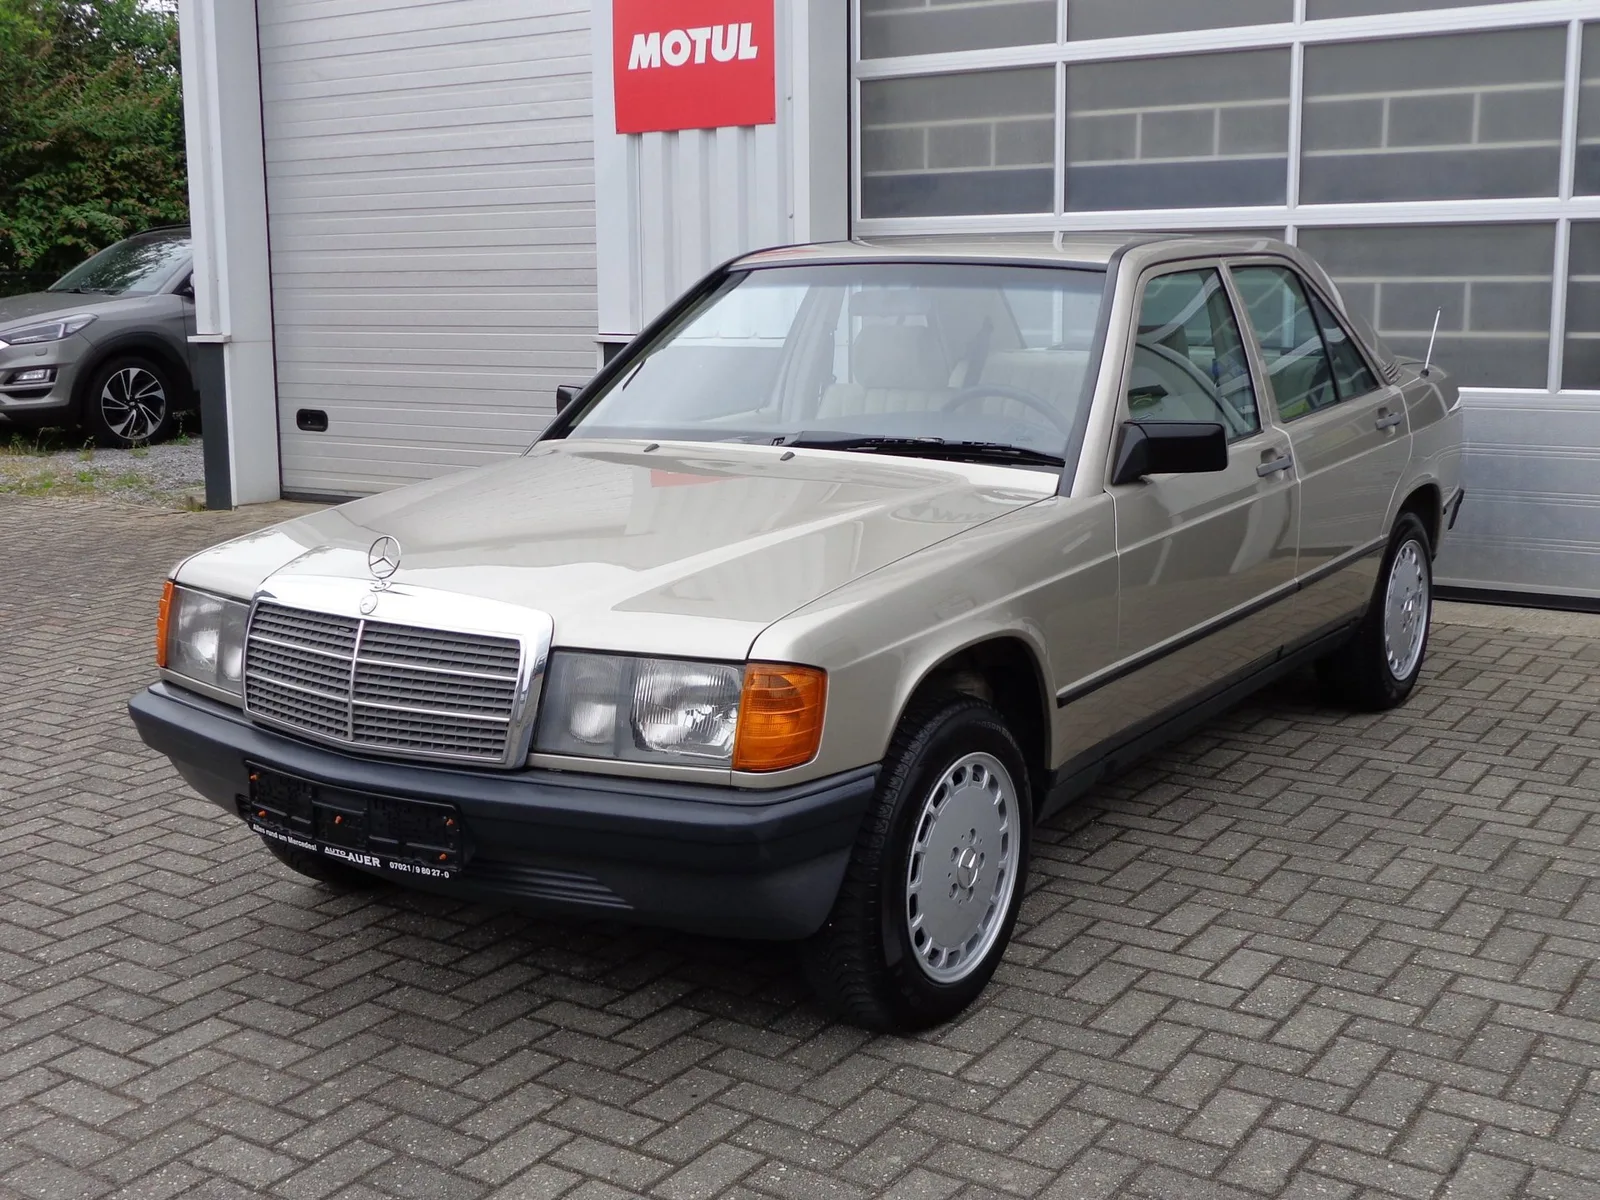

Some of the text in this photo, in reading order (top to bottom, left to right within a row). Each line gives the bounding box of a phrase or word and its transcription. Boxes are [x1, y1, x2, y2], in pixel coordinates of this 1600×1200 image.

[628, 23, 758, 70] MOTUL
[324, 846, 346, 857] AUTO
[347, 852, 381, 867] AUER
